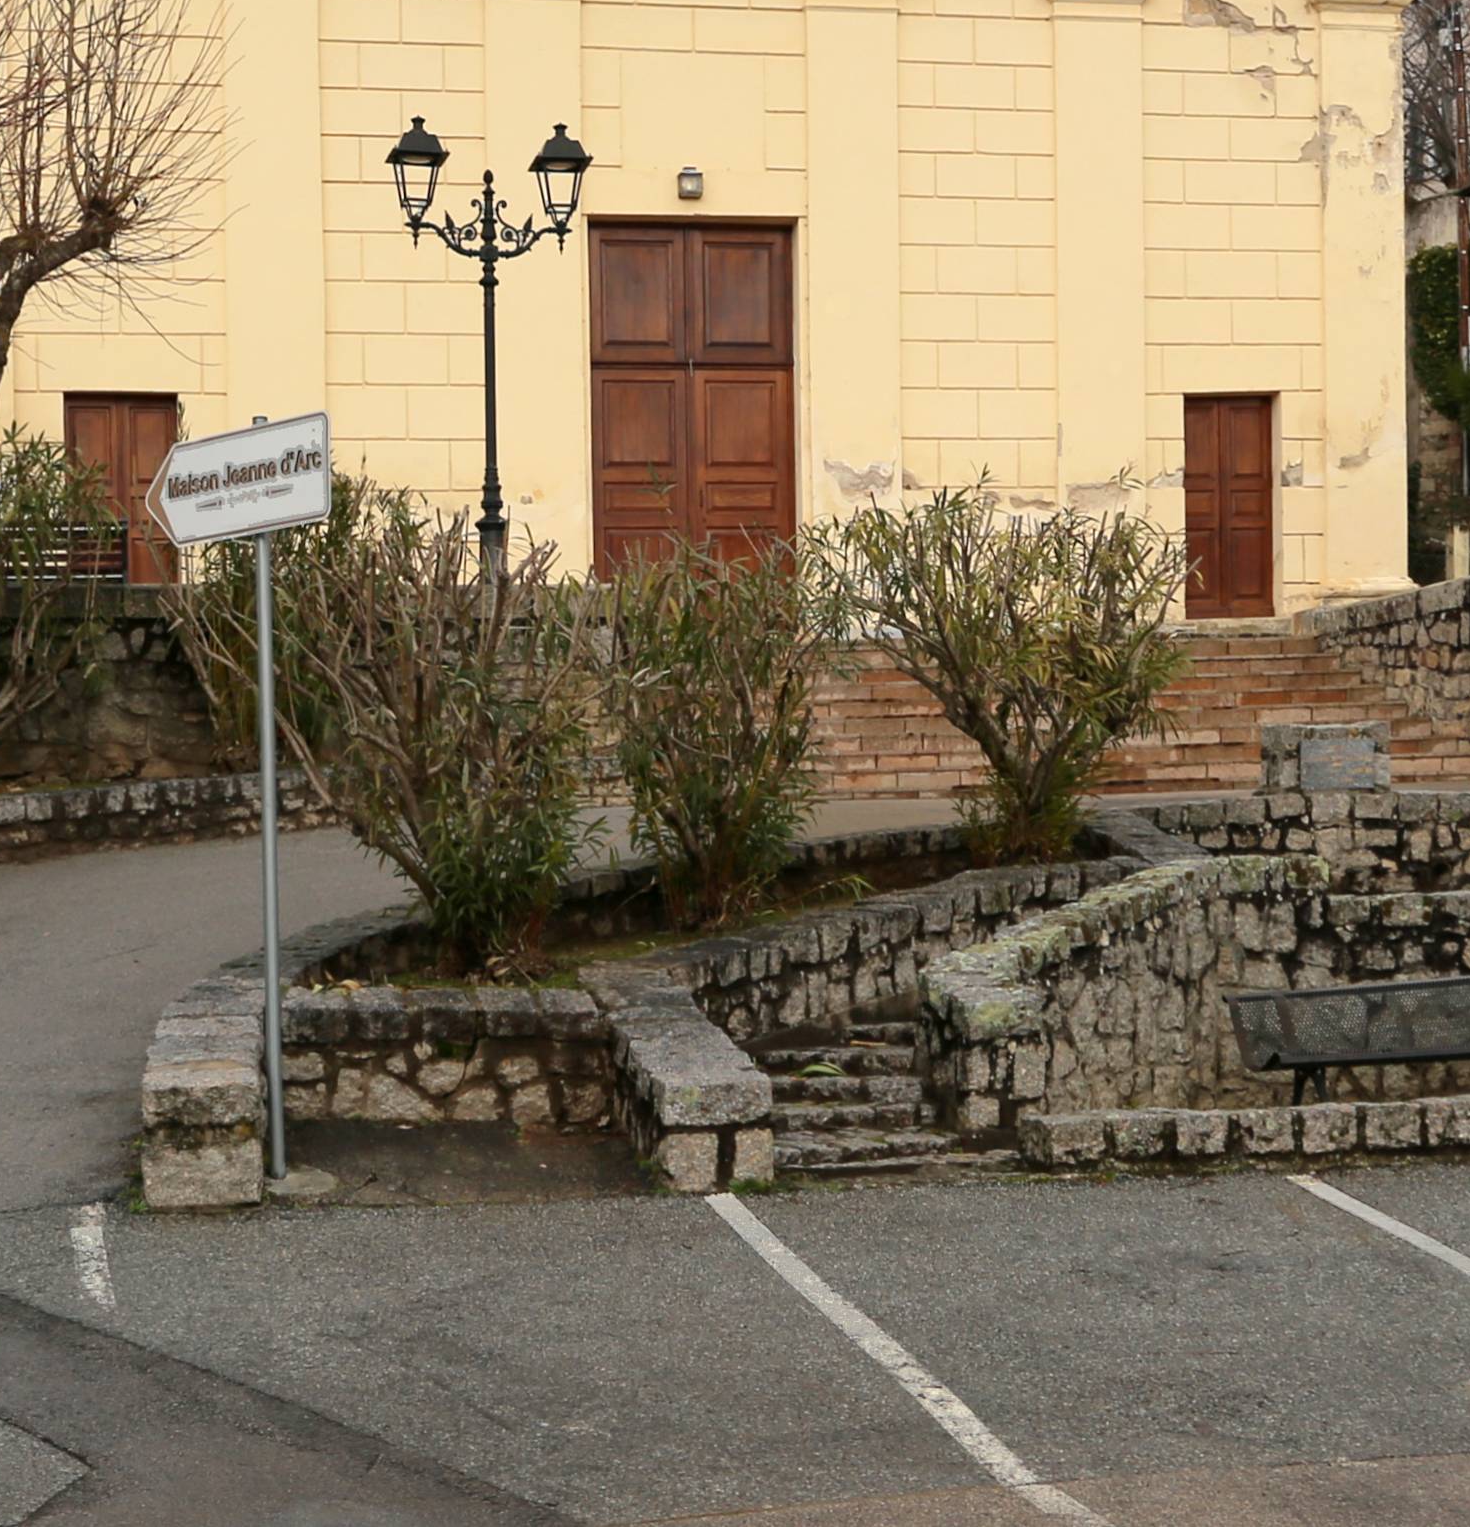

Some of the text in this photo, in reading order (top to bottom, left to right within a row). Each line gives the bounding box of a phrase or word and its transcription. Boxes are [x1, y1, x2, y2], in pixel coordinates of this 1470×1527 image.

[168, 449, 322, 499] Maison Jeanne d'Arc
